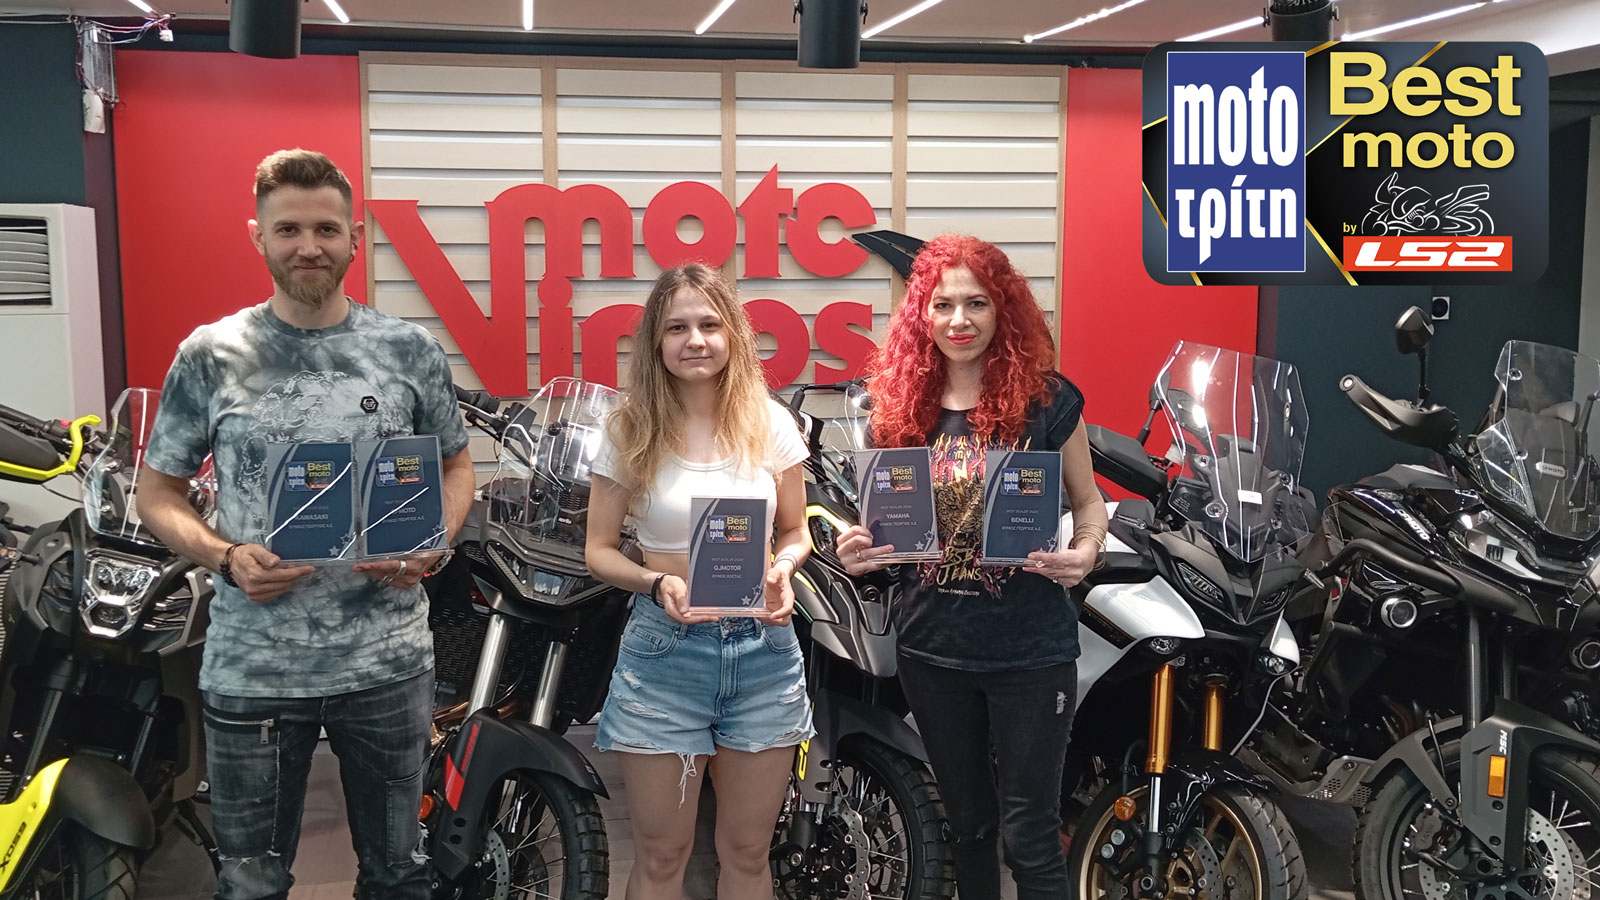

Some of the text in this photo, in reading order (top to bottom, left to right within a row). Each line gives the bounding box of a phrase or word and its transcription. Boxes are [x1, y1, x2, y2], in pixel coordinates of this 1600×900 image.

[307, 462, 332, 471] Best
[396, 457, 419, 466] Best
[1004, 472, 1018, 482] moto
[710, 518, 724, 530] moto
[1398, 508, 1430, 540] CFMOTO
[937, 564, 982, 585] JEANS
[1499, 730, 1508, 755] MSC
